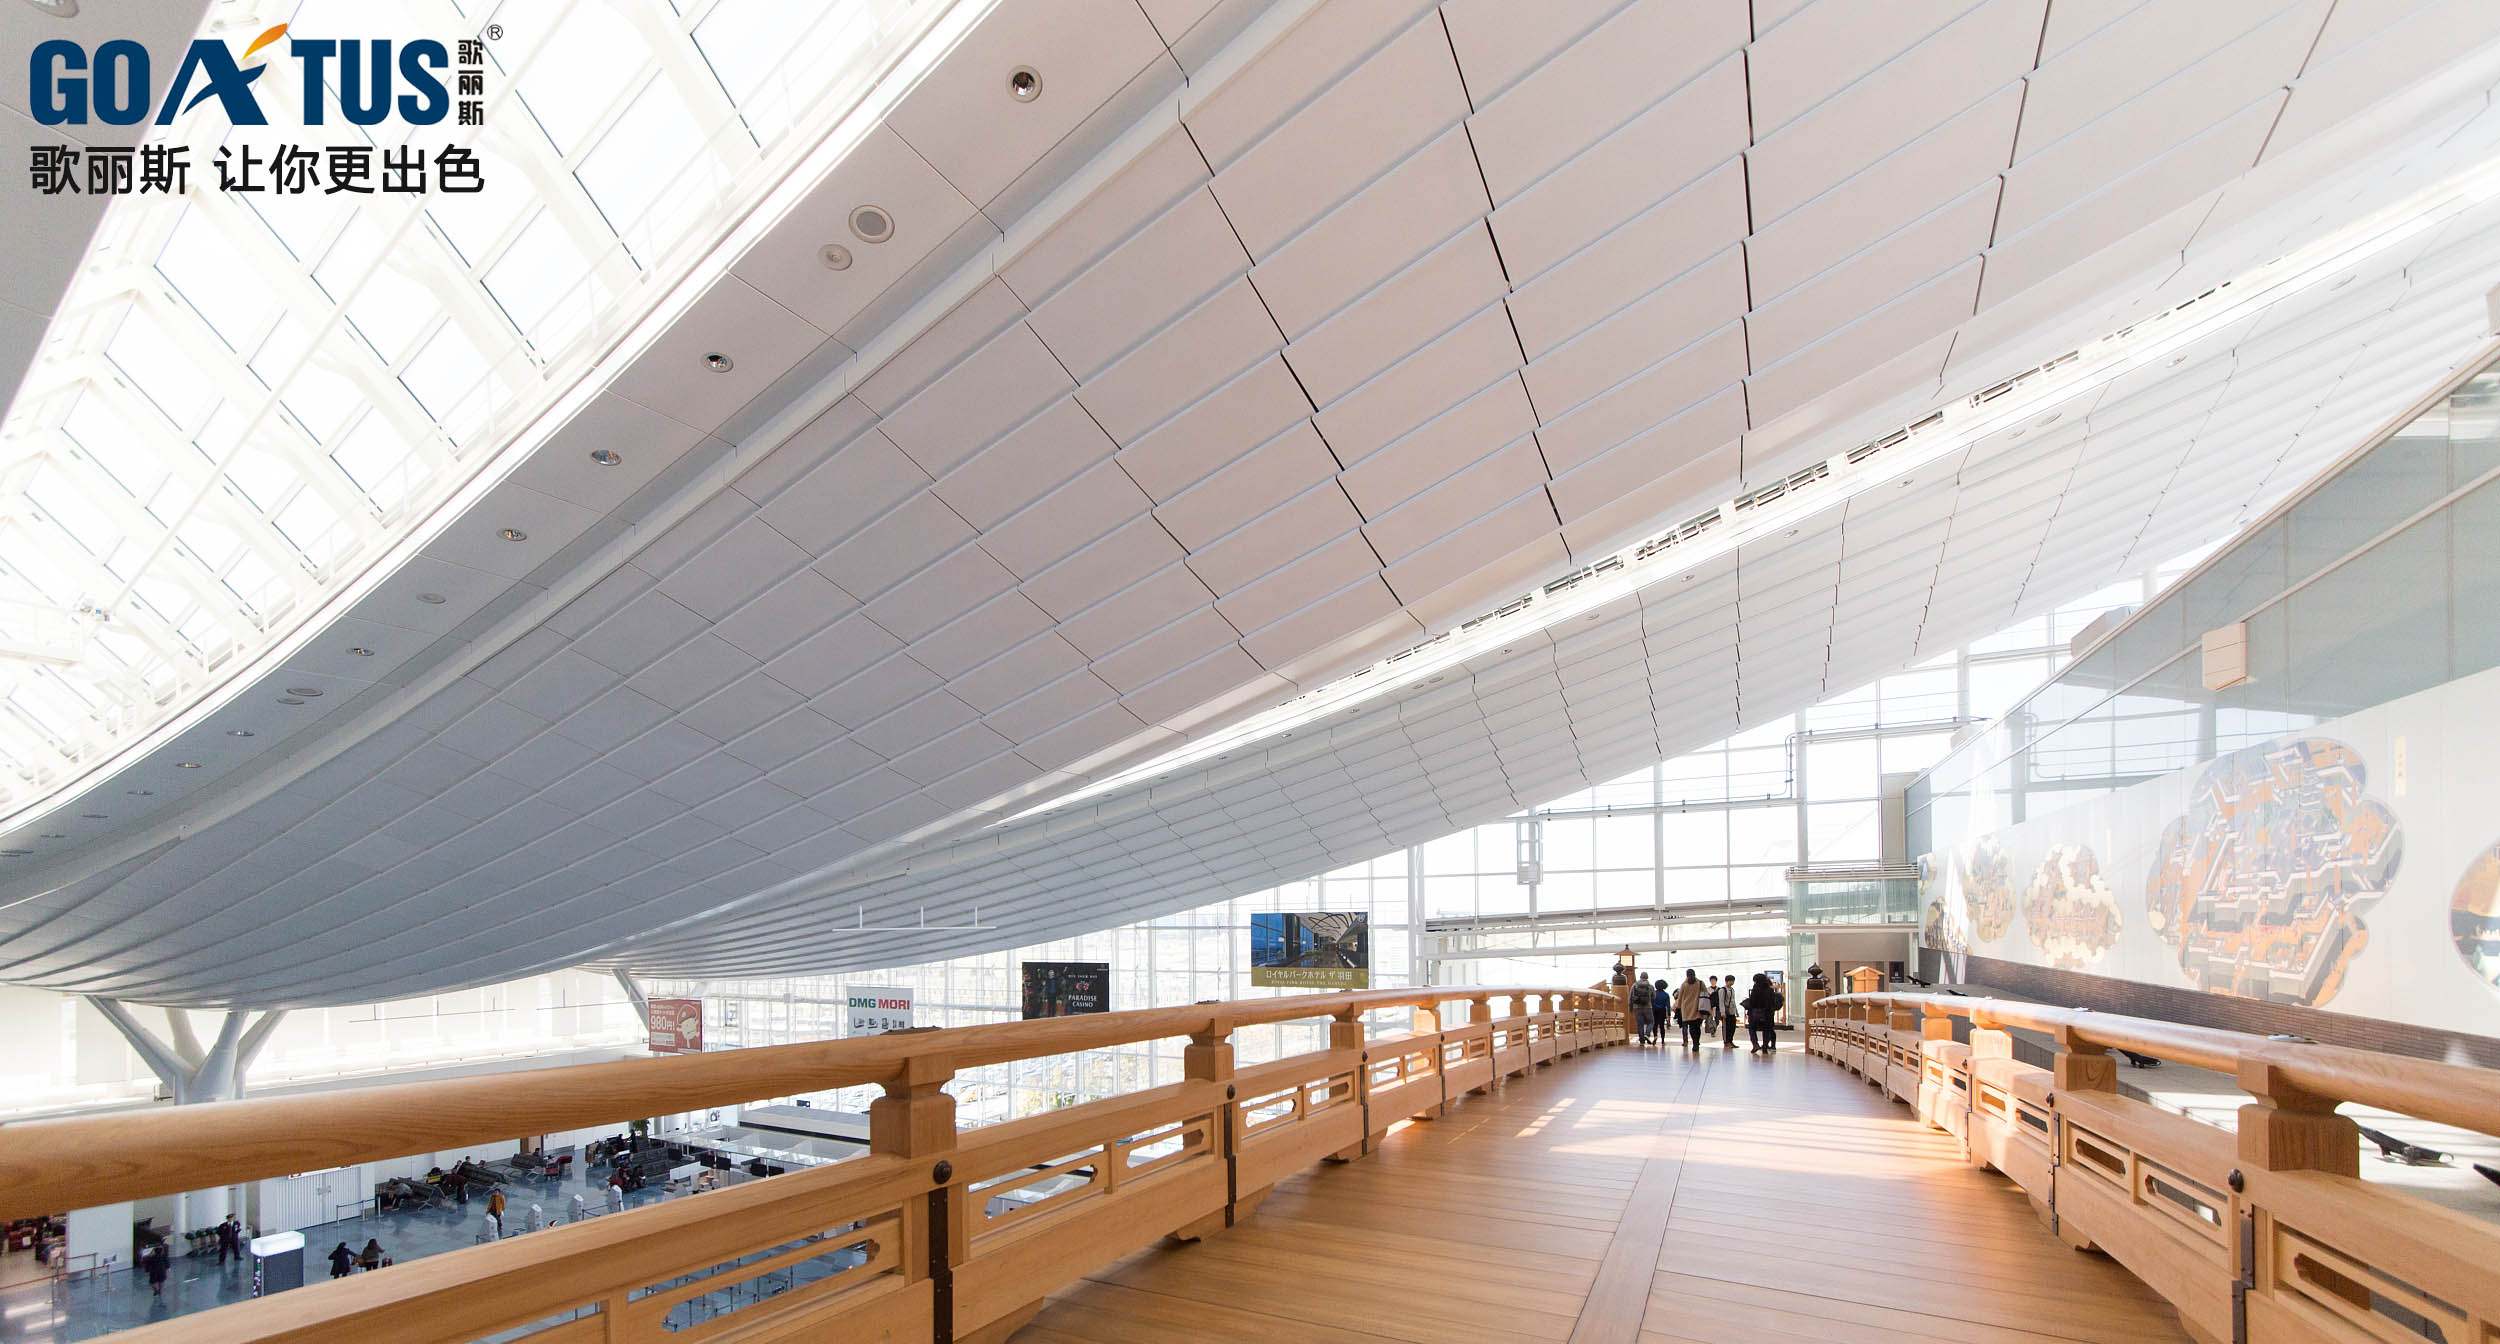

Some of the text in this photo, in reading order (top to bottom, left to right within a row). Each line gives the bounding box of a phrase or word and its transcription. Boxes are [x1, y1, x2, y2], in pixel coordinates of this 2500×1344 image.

[1068, 994, 1097, 1002] PARADISE
[849, 997, 910, 1011] DMG MORI
